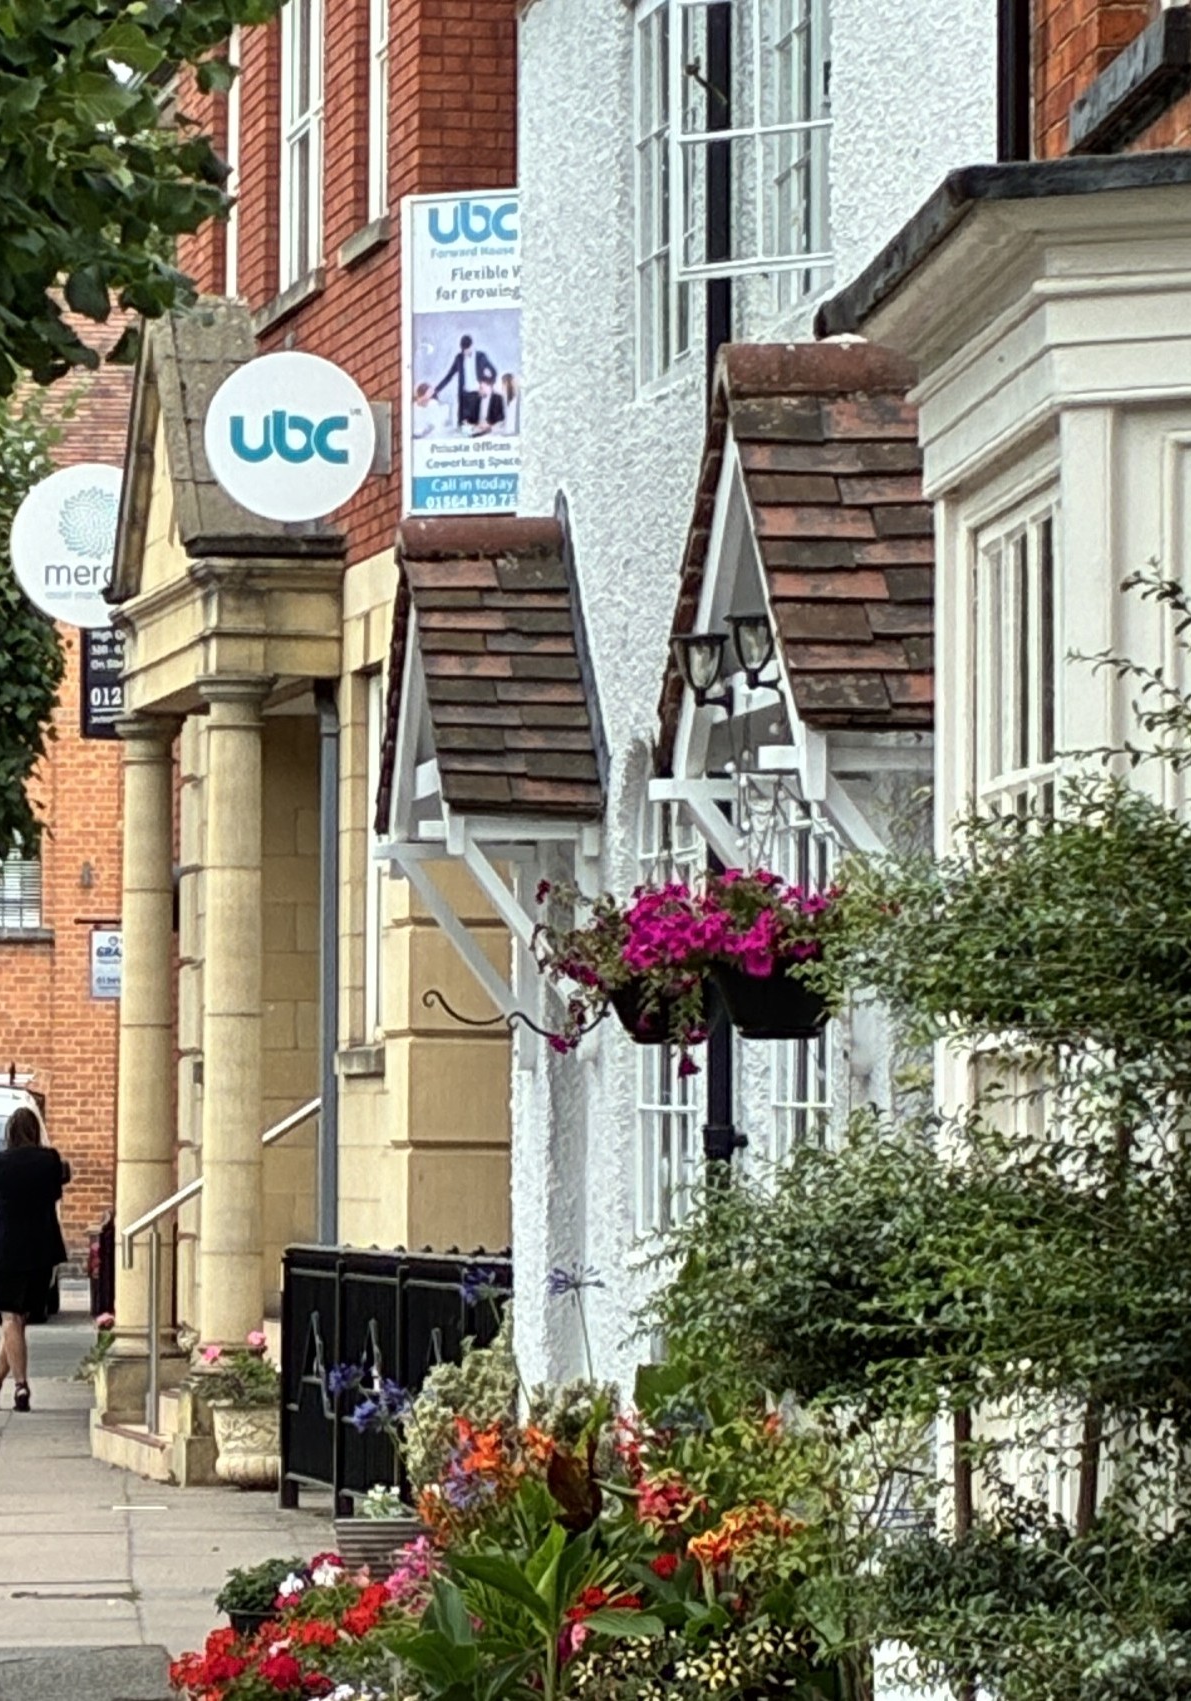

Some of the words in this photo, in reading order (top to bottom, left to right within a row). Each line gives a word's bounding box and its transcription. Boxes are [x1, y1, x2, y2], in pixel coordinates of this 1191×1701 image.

[428, 201, 518, 244] ubc
[451, 265, 509, 281] Flexible
[436, 286, 457, 301] for
[230, 410, 349, 464] ubc
[431, 478, 457, 492] Call
[459, 478, 472, 490] in
[475, 476, 515, 492] today
